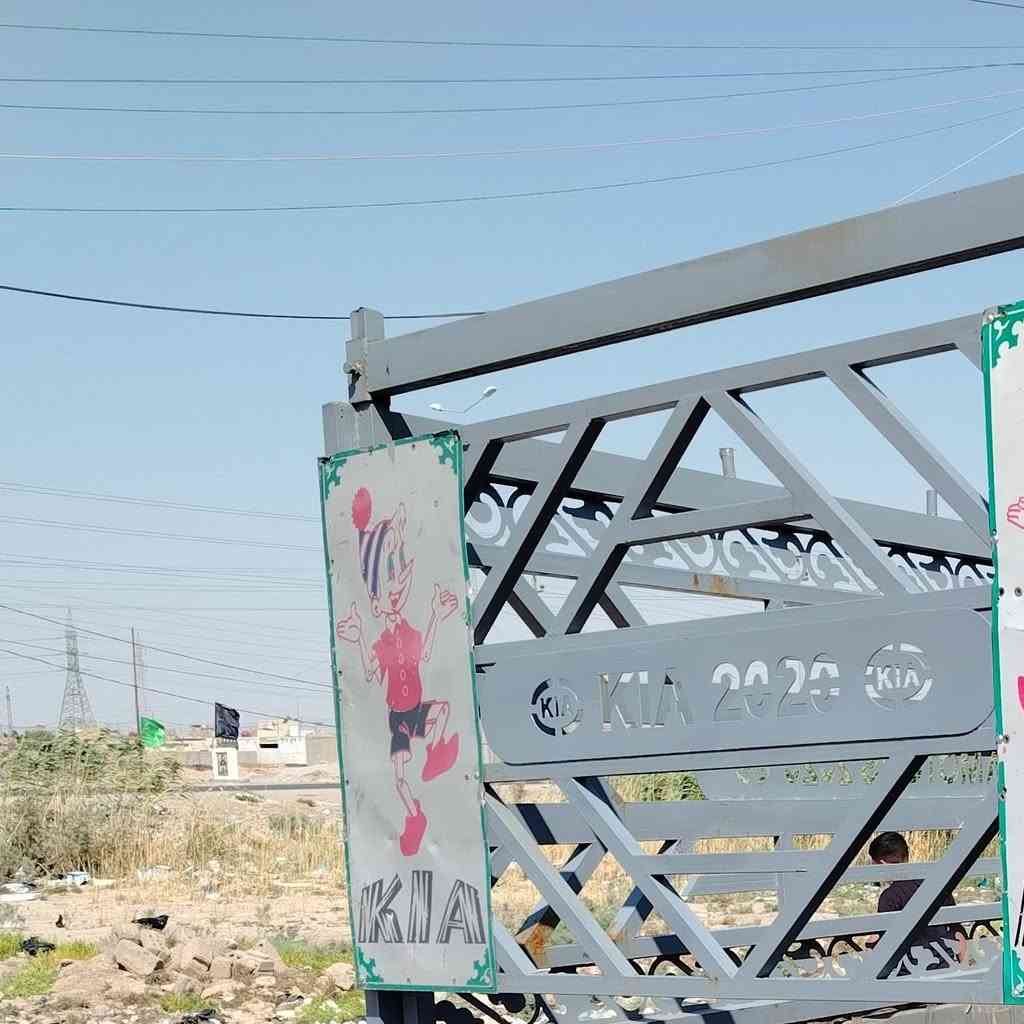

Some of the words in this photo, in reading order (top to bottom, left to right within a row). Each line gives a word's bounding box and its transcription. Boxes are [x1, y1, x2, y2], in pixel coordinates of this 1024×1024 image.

[600, 668, 694, 733] KIA
[711, 651, 841, 721] 2020
[358, 870, 487, 944] KIA
